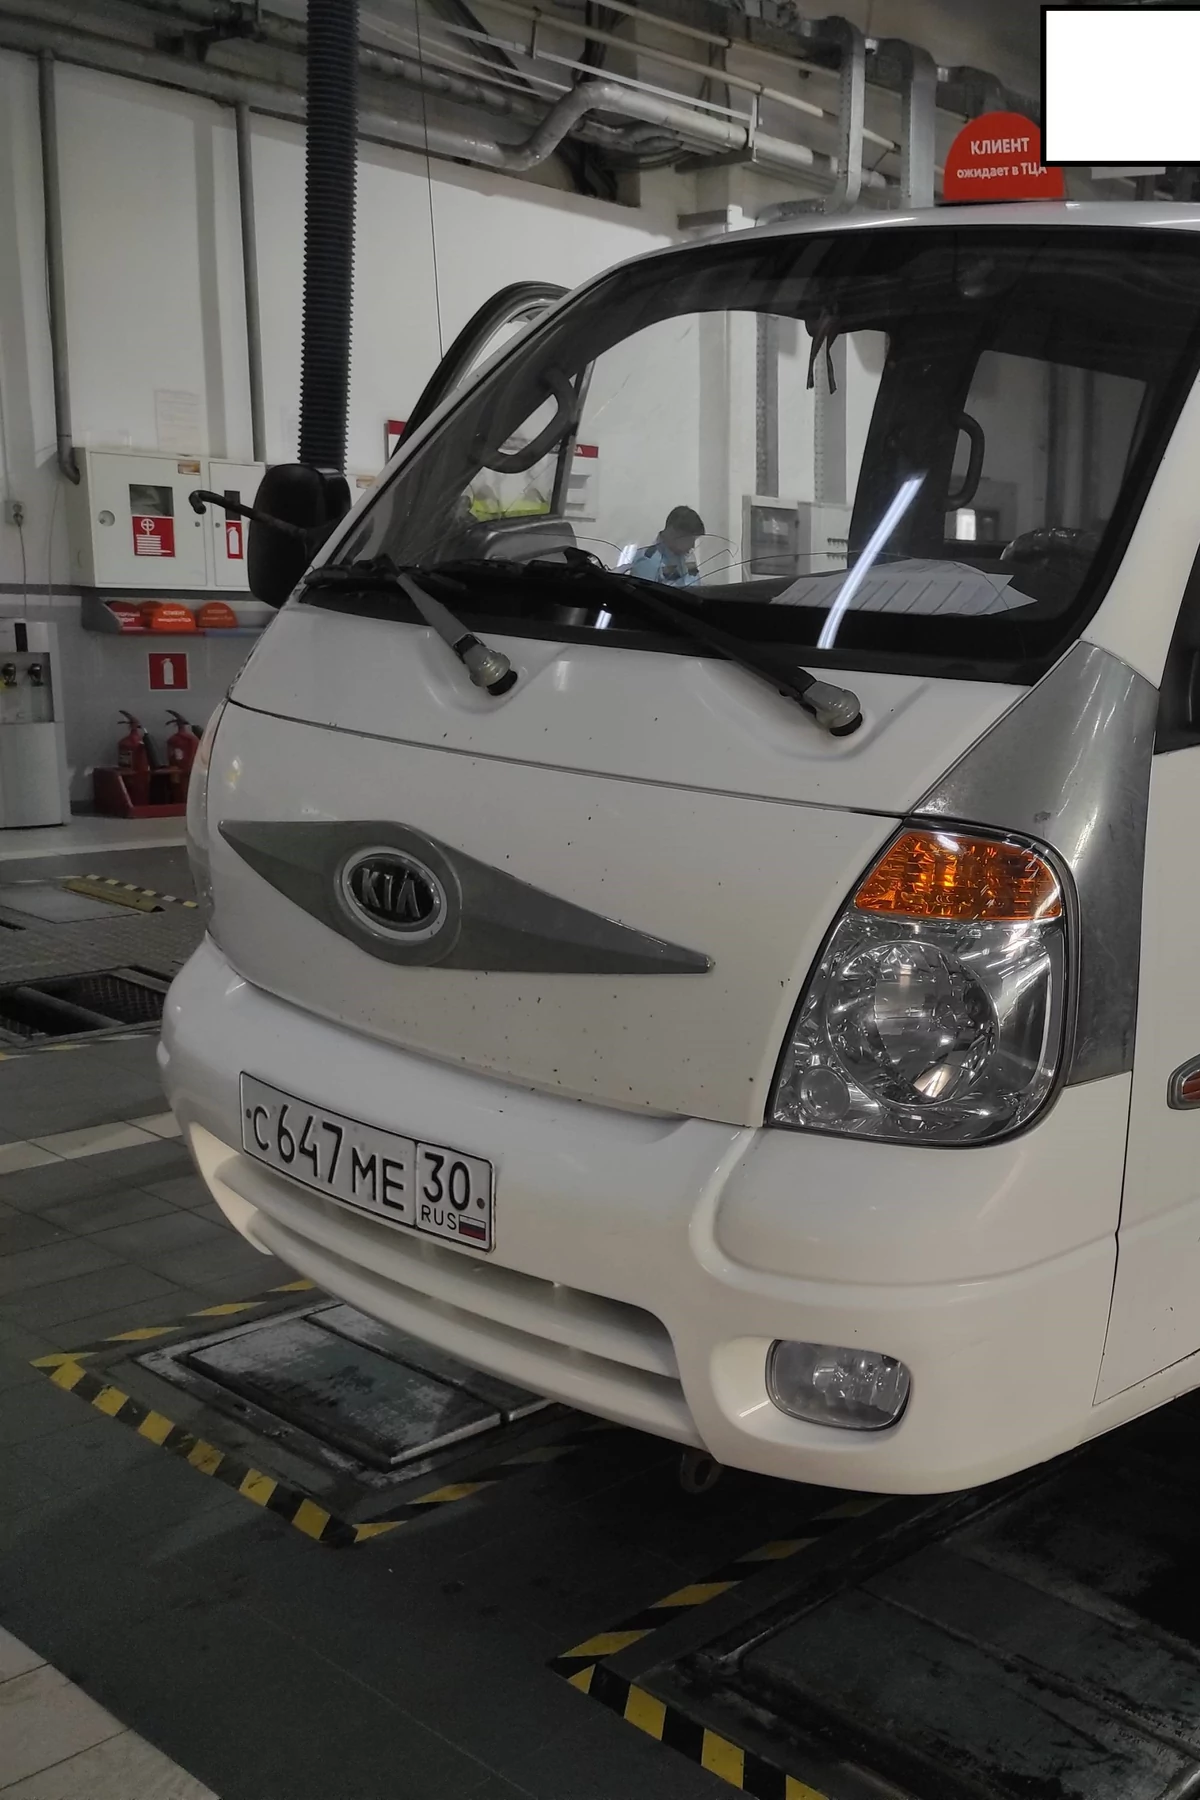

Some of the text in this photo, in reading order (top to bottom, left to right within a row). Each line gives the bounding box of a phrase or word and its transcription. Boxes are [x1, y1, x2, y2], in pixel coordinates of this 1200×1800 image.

[970, 137, 1030, 155] КЛИЕНТ
[956, 165, 1010, 180] ожидает
[1011, 165, 1020, 176] в
[361, 866, 421, 919] KIA
[252, 1103, 472, 1212] С647МЕ 30
[421, 1204, 458, 1231] RUS
